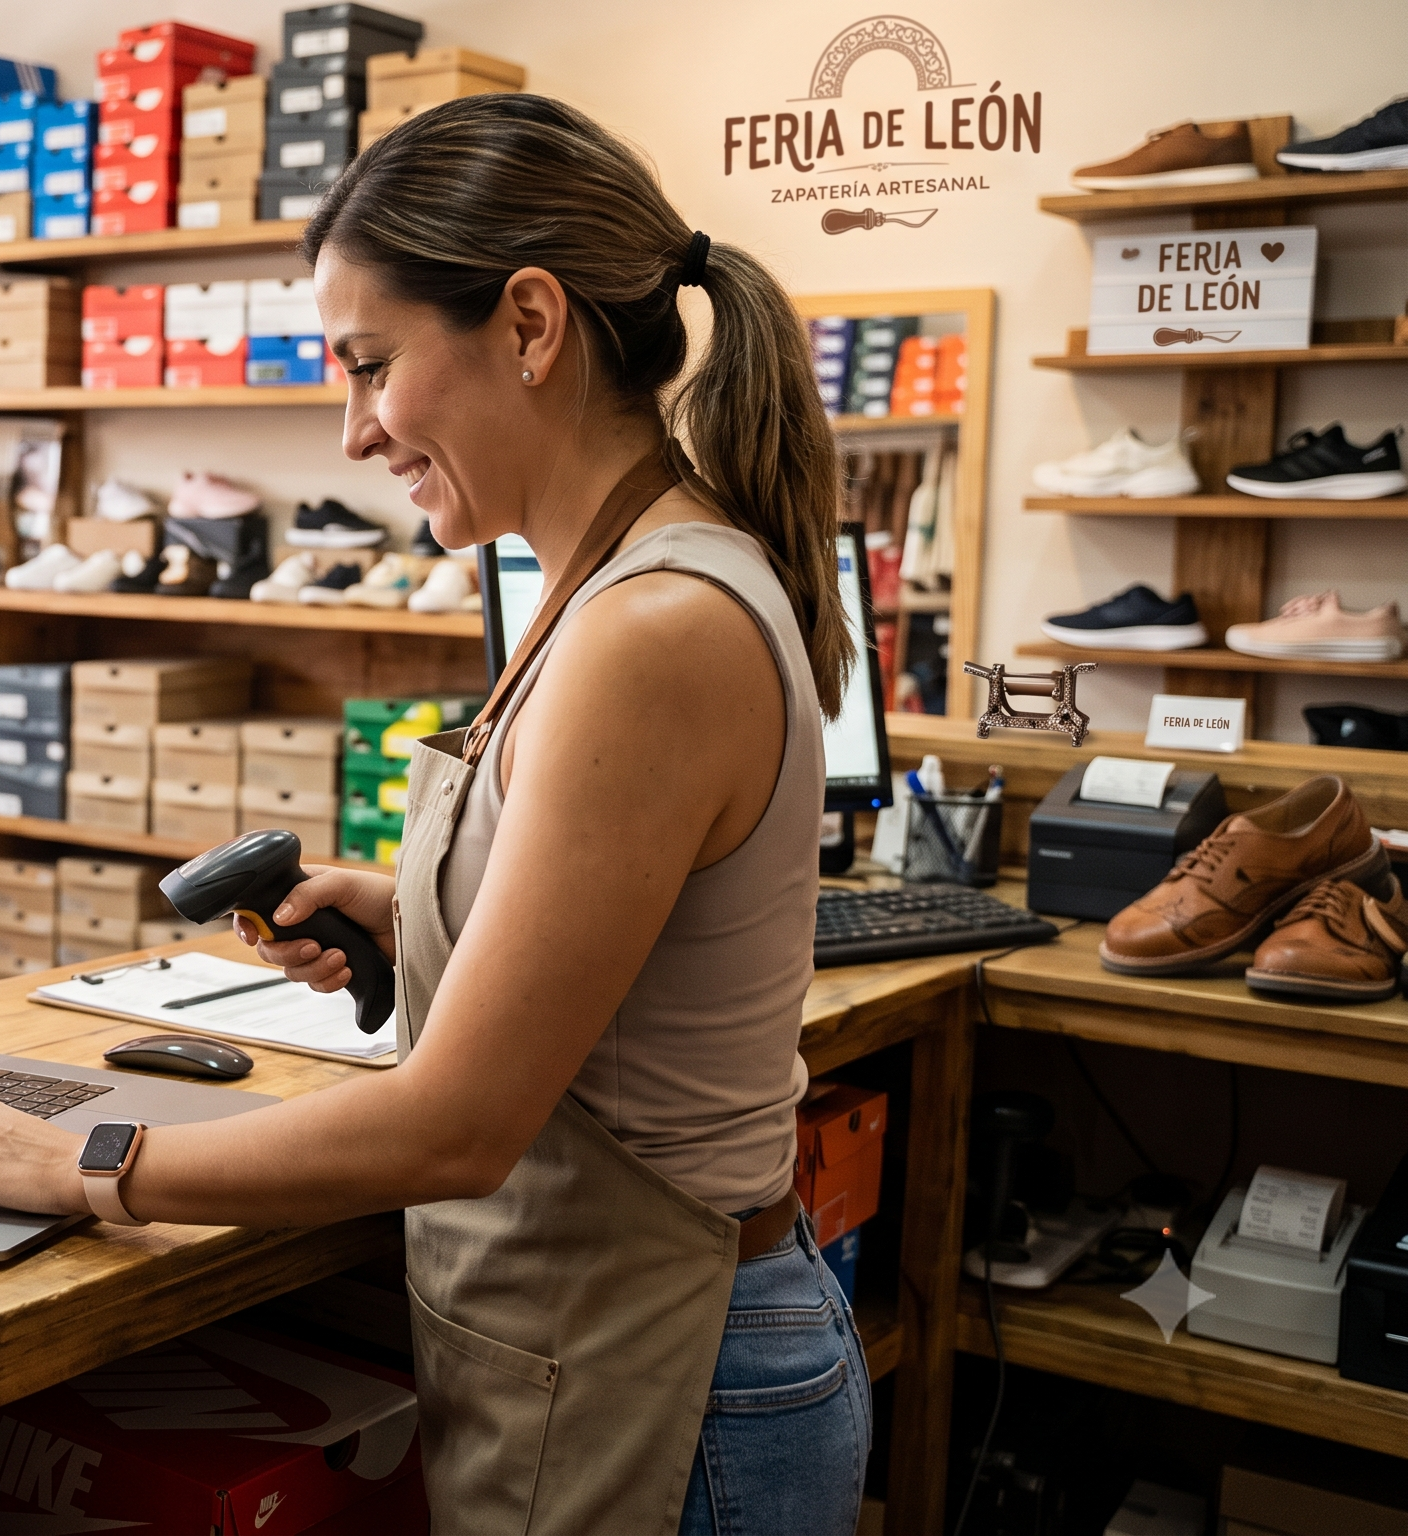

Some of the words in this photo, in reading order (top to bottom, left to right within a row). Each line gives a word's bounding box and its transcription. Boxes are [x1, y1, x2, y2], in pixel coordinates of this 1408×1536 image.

[724, 109, 844, 176] FERIA
[864, 109, 904, 149] DE
[924, 80, 1042, 154] LEÓN
[772, 181, 870, 203] ZAPATERÍA
[877, 176, 990, 195] ARTESANAL
[1158, 240, 1242, 276] FERIA
[1138, 282, 1173, 314] DE
[1185, 274, 1260, 311] LEÓN
[1163, 716, 1190, 728] FERIA
[1193, 718, 1204, 728] DE
[1206, 717, 1230, 730] LEÓN
[260, 1490, 280, 1514] NIKE
